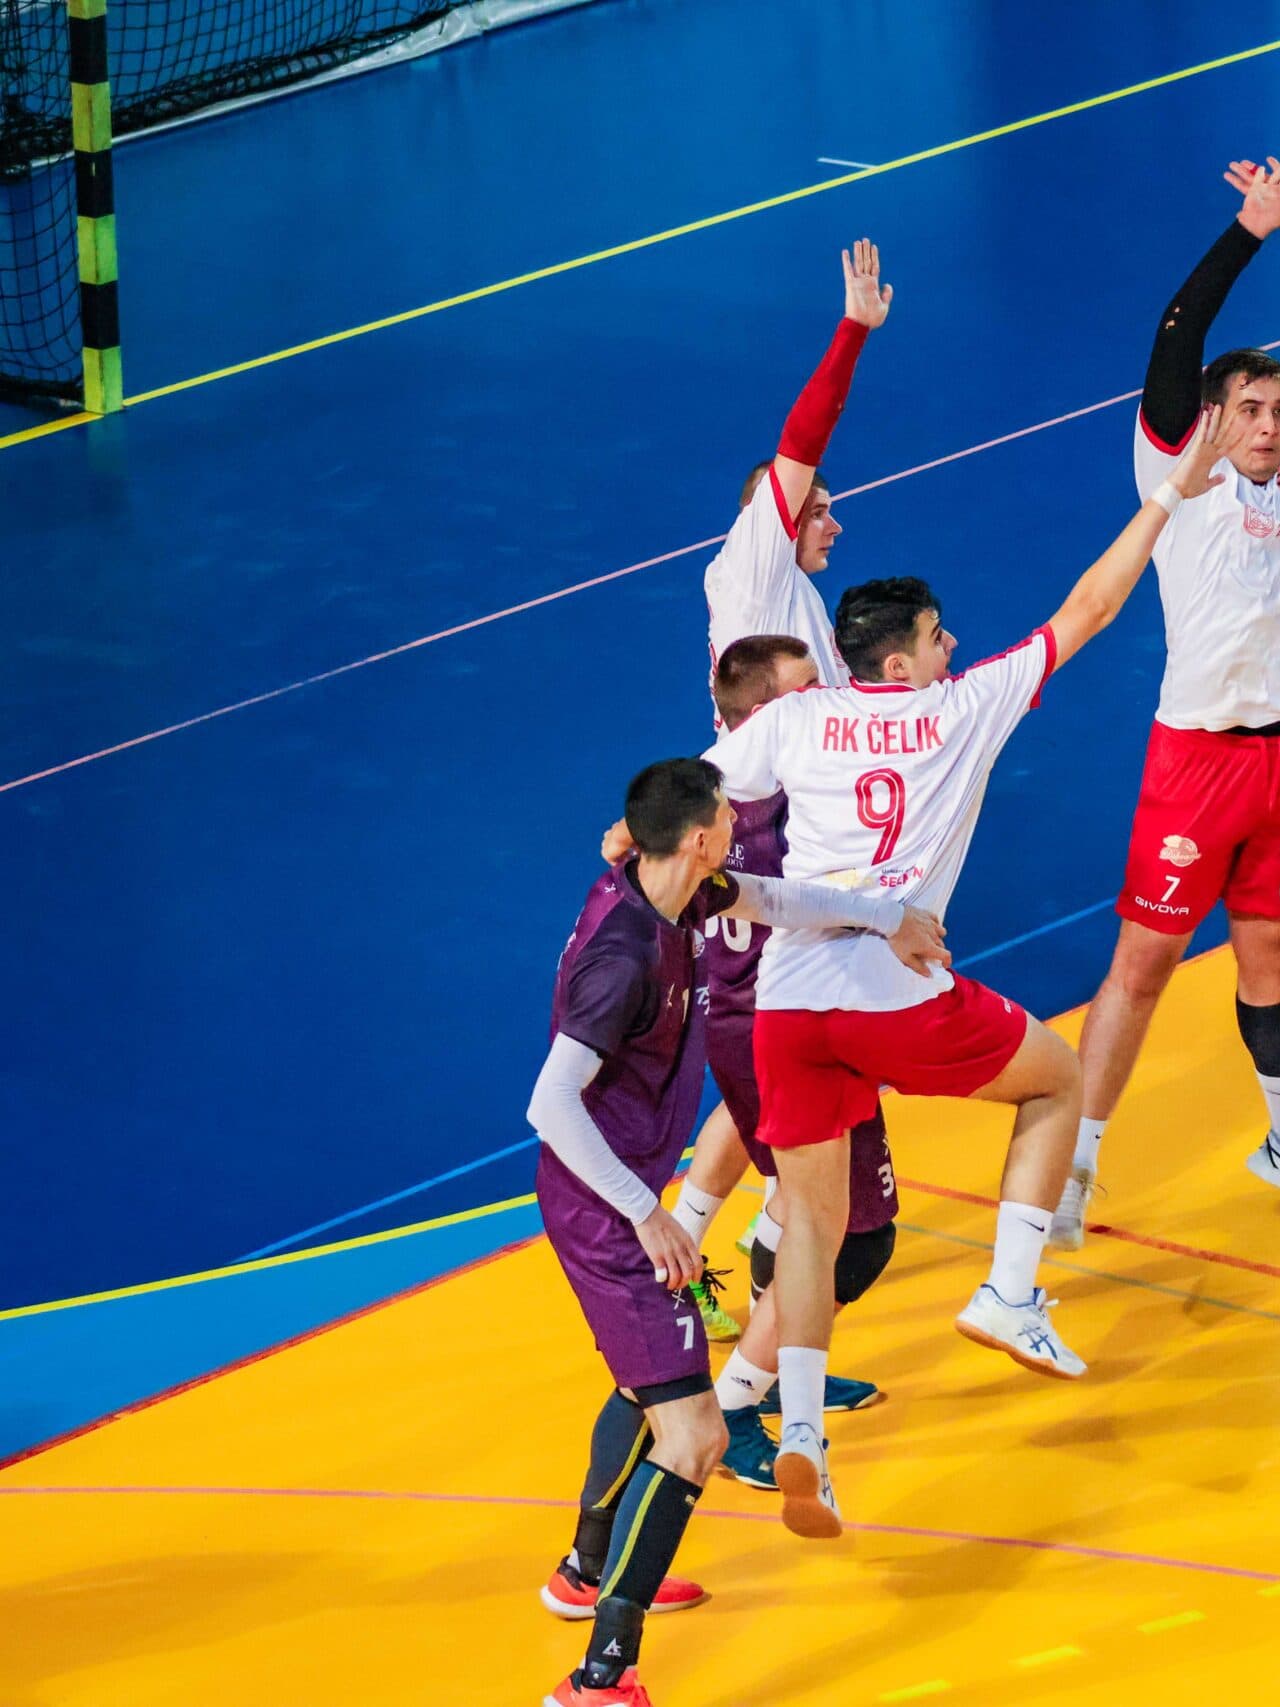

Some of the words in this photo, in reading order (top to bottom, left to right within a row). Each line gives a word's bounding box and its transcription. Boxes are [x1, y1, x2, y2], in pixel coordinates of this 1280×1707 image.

[822, 716, 860, 752] RK
[866, 713, 945, 755] ČELIK
[854, 767, 906, 866] 9
[1134, 895, 1190, 916] GIVOVA
[1161, 875, 1181, 902] 7
[676, 1315, 695, 1351] 7
